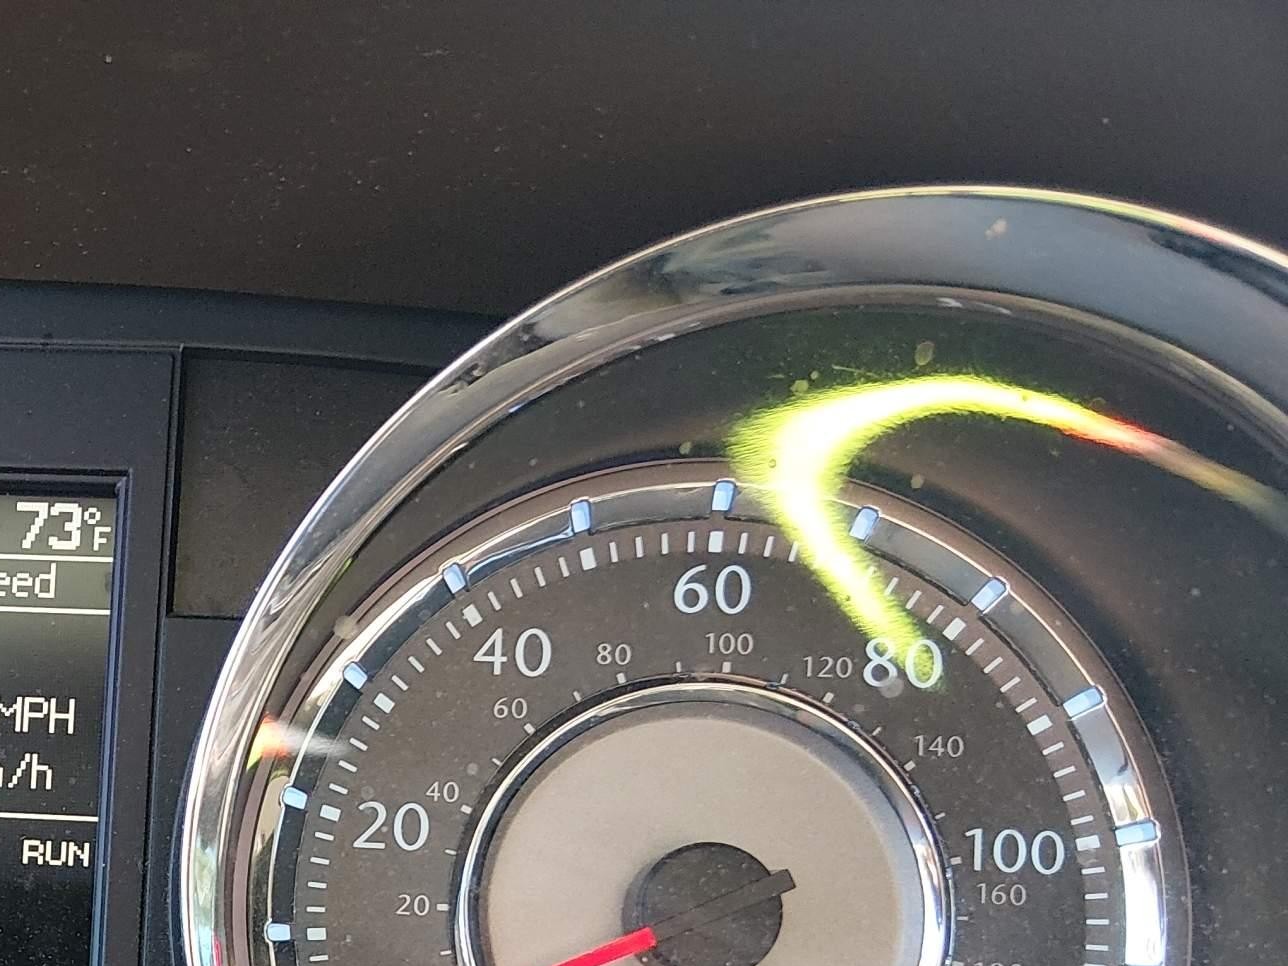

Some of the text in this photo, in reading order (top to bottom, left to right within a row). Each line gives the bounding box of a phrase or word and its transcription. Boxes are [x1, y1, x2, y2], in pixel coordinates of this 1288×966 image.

[674, 565, 751, 614] 60
[474, 628, 551, 677] 40
[597, 643, 631, 665] 80
[705, 633, 754, 657] 100
[803, 656, 853, 681] 120
[863, 636, 944, 690] 80
[494, 697, 528, 721] 60
[914, 735, 964, 760] 140
[426, 781, 461, 802] 40
[353, 801, 429, 852] 20
[22, 840, 90, 867] RUN
[965, 828, 1065, 877] 100
[395, 894, 430, 917] 20
[975, 881, 1026, 907] 160
